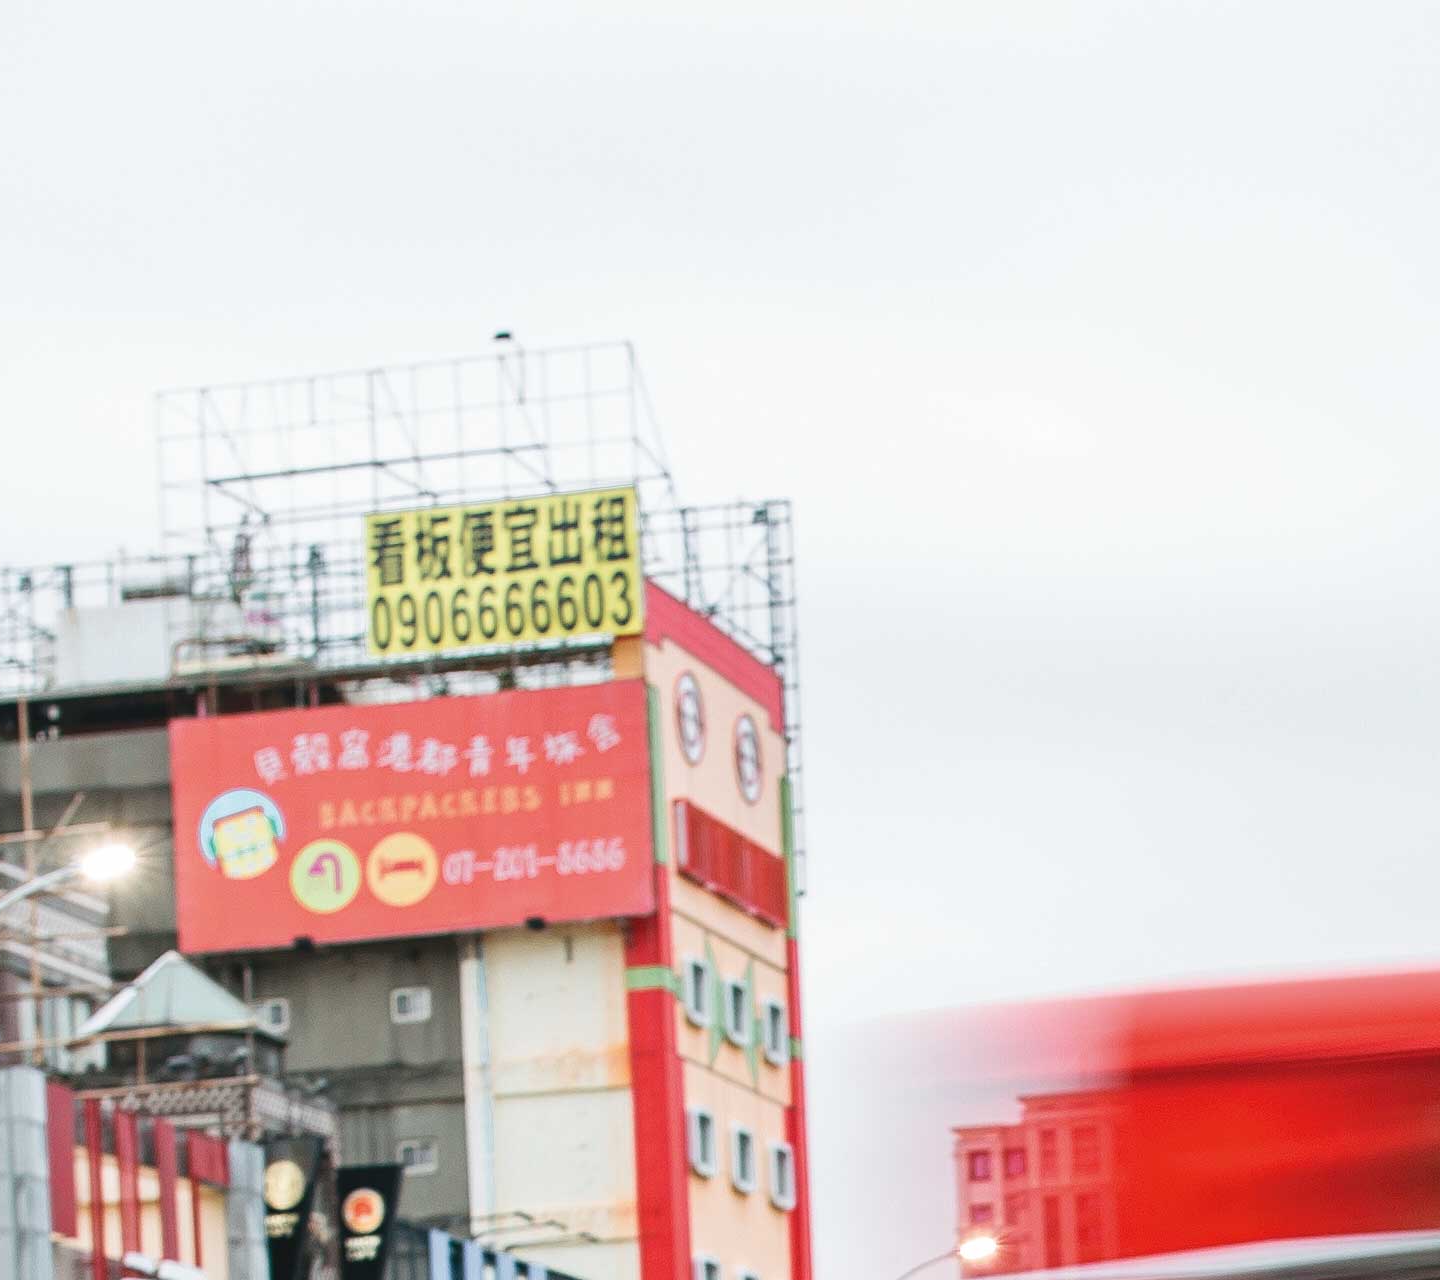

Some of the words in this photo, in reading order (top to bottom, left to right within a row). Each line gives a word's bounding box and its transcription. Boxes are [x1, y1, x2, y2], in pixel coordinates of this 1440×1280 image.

[370, 496, 631, 586] 看板便宜出租
[372, 571, 633, 650] 0906666603
